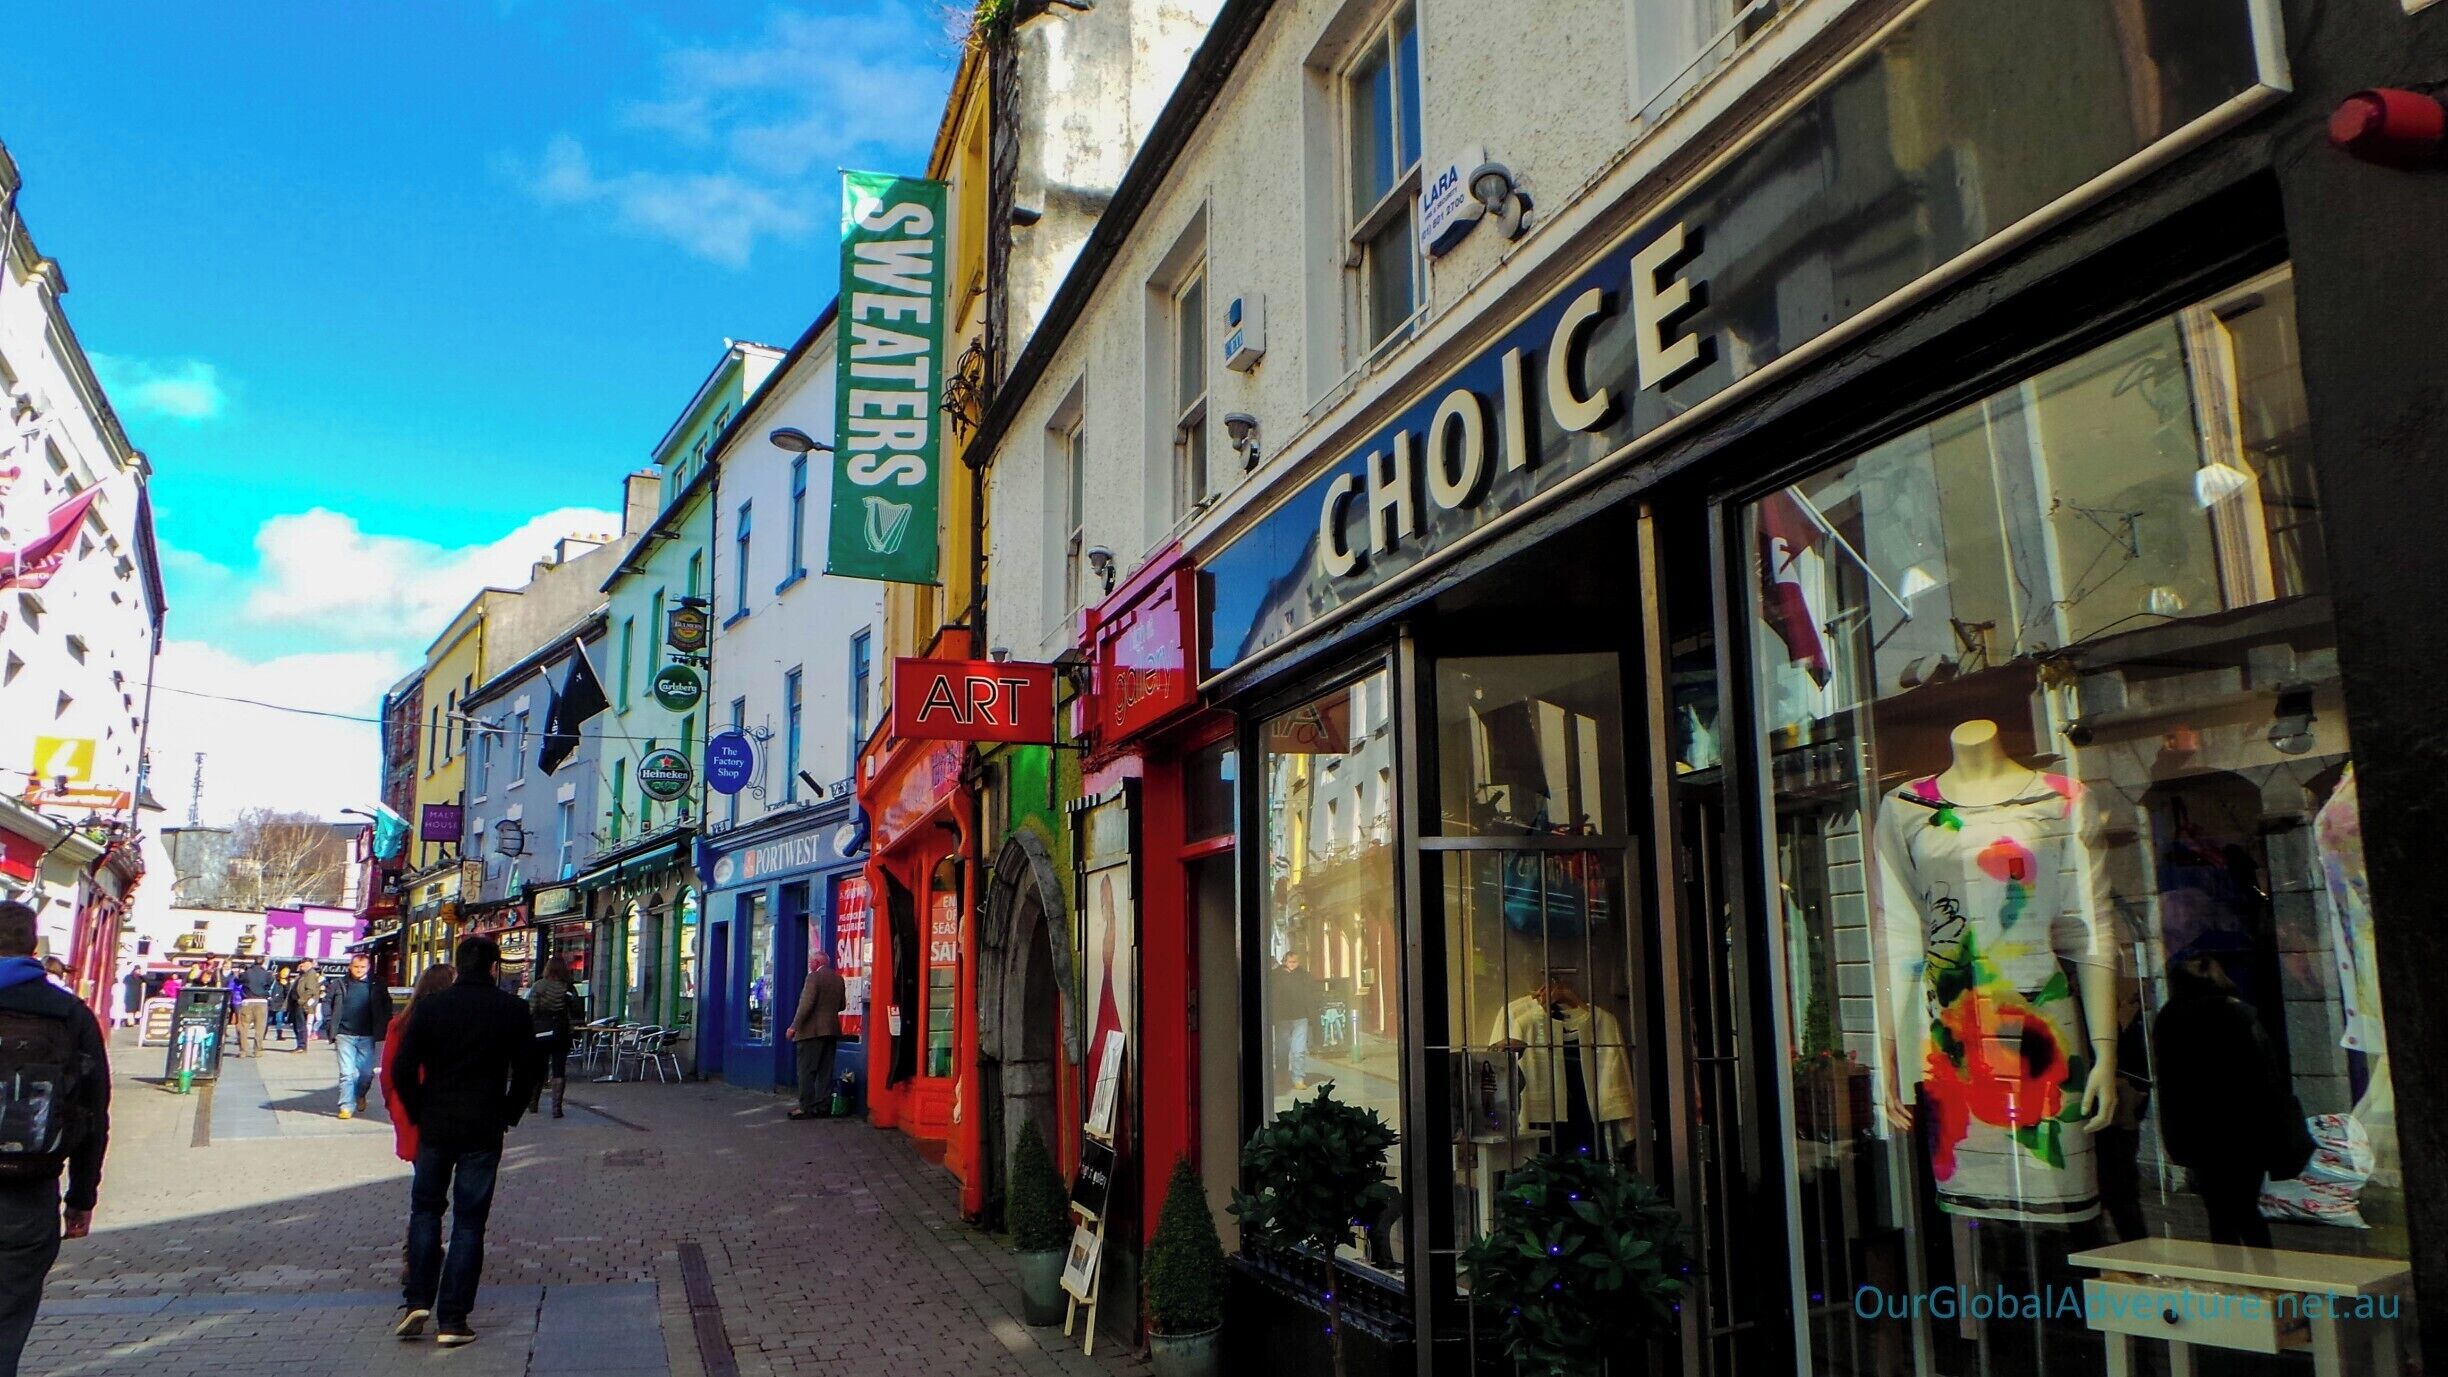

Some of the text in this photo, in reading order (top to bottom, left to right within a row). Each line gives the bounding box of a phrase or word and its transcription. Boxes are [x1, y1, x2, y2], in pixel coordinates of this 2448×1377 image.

[1423, 165, 1458, 211] LARA
[1446, 194, 1465, 216] 2700
[847, 192, 934, 486] SWEATERS
[1319, 221, 1699, 577] CHOICE
[658, 679, 698, 693] Carlsberg
[916, 674, 1030, 726] ART
[722, 747, 738, 756] The
[713, 756, 745, 768] Factory
[642, 769, 689, 780] Heineken
[717, 768, 739, 779] Shop
[429, 811, 455, 819] MALT
[424, 821, 458, 829] HOUSE
[755, 834, 820, 876] PORTWEST
